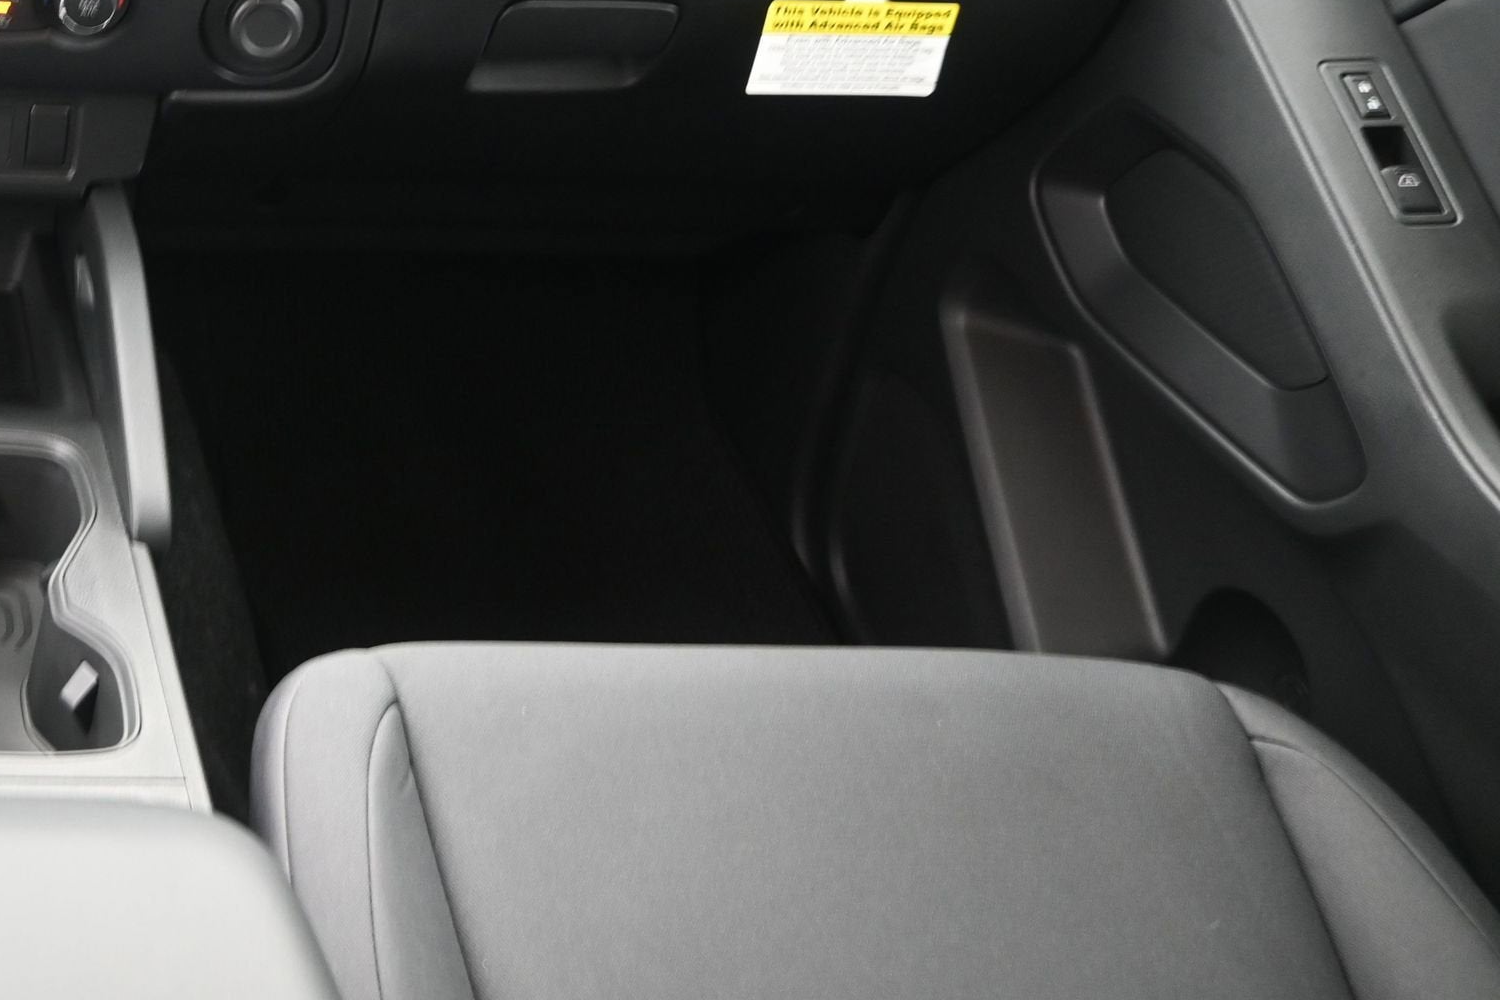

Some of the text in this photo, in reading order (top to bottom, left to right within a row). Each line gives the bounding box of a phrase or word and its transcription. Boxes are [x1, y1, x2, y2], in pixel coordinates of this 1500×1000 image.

[775, 6, 952, 21] This Vehicle is Equipped
[772, 21, 944, 35] with Advanced Air Bags
